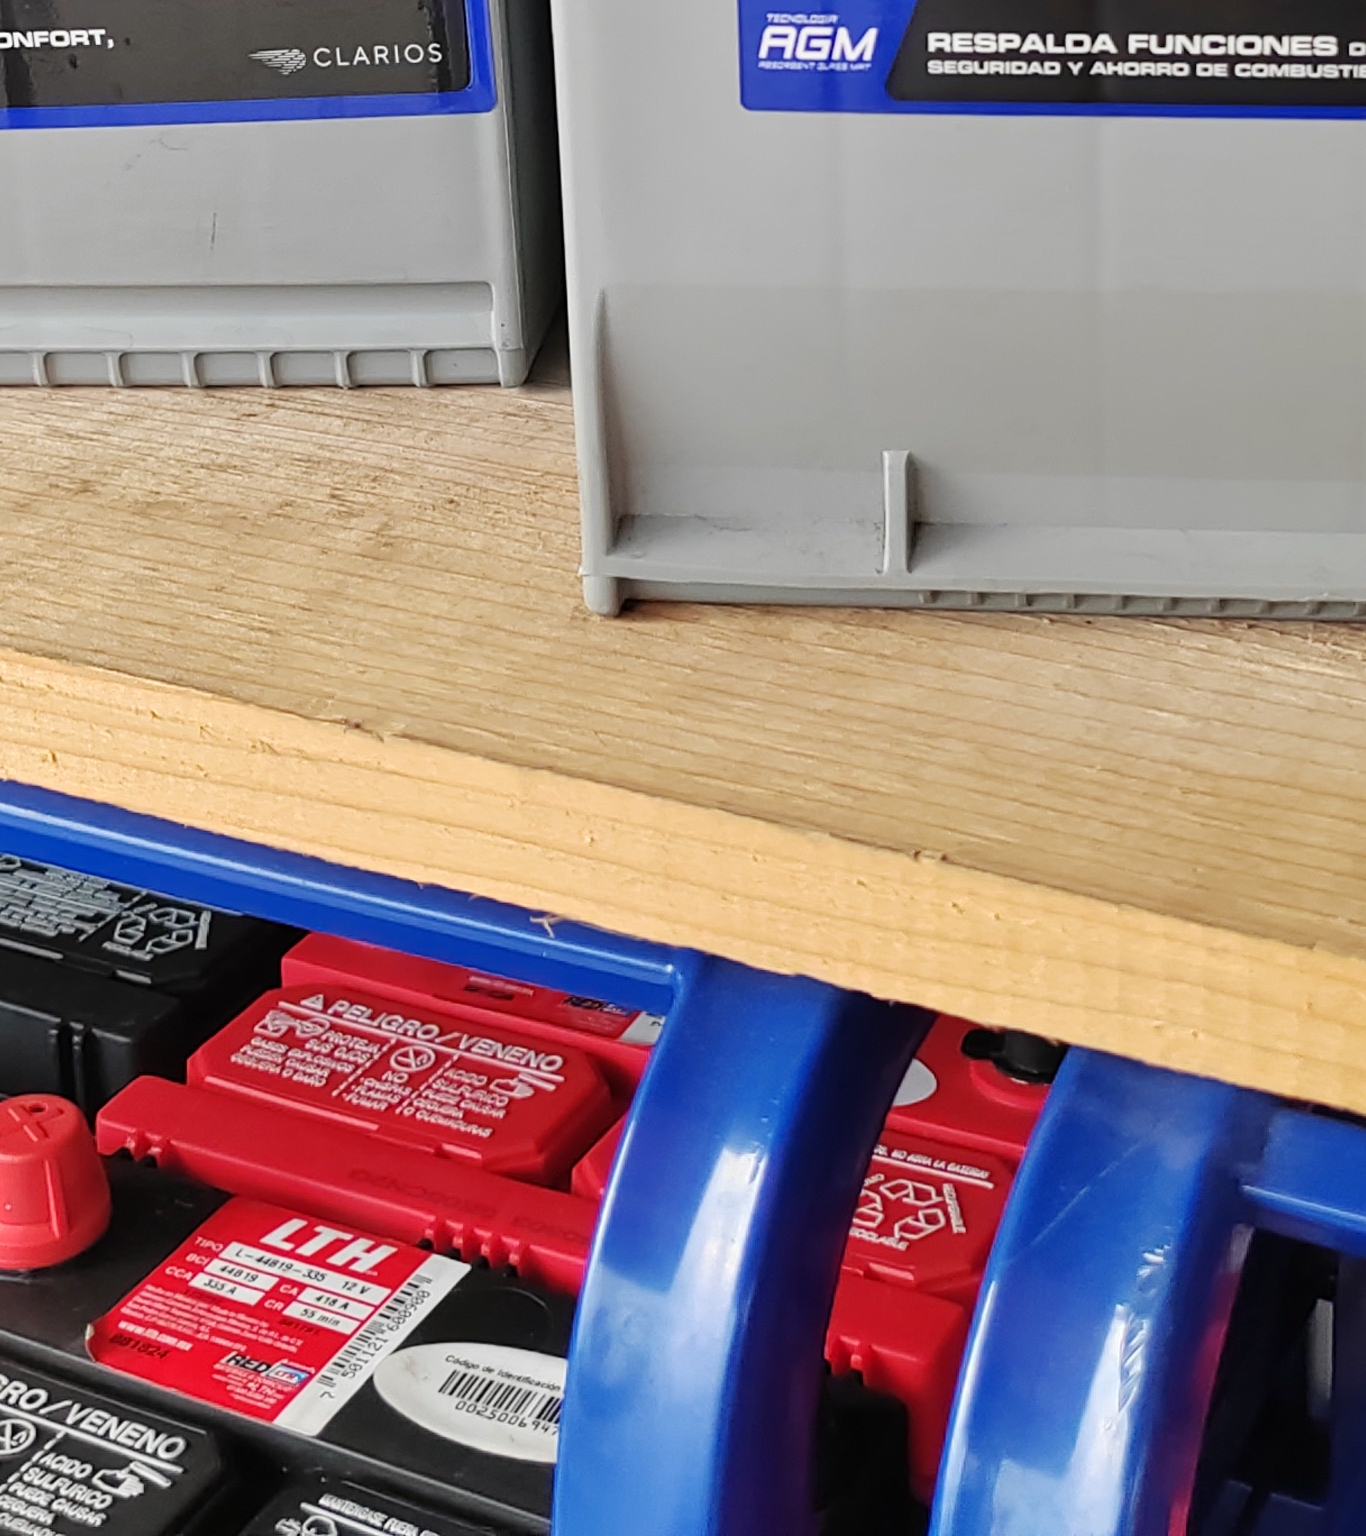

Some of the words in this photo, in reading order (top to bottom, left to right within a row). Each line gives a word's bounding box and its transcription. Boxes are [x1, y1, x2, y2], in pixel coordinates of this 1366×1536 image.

[312, 43, 442, 69] CLARIOS
[758, 25, 878, 62] AGM
[927, 33, 1117, 54] RESPALDA
[1128, 35, 1337, 56] FUNCIONES
[927, 60, 1060, 76] SEGURIDAD
[1067, 62, 1083, 76] Y
[1089, 61, 1190, 77] AHORRO
[1197, 63, 1228, 77] DE
[382, 1071, 409, 1083] NO
[260, 1217, 396, 1273] LTH
[186, 1253, 210, 1266] BCI
[219, 1265, 257, 1284] 44819
[194, 1236, 223, 1253] TIPO
[236, 1248, 326, 1282] L-44819-335
[164, 1265, 192, 1282] CCA
[226, 1285, 237, 1296] A
[264, 1299, 284, 1311] CR
[279, 1283, 299, 1296] CA
[339, 1300, 349, 1311] A
[445, 1354, 480, 1370] Código
[482, 1364, 495, 1374] de
